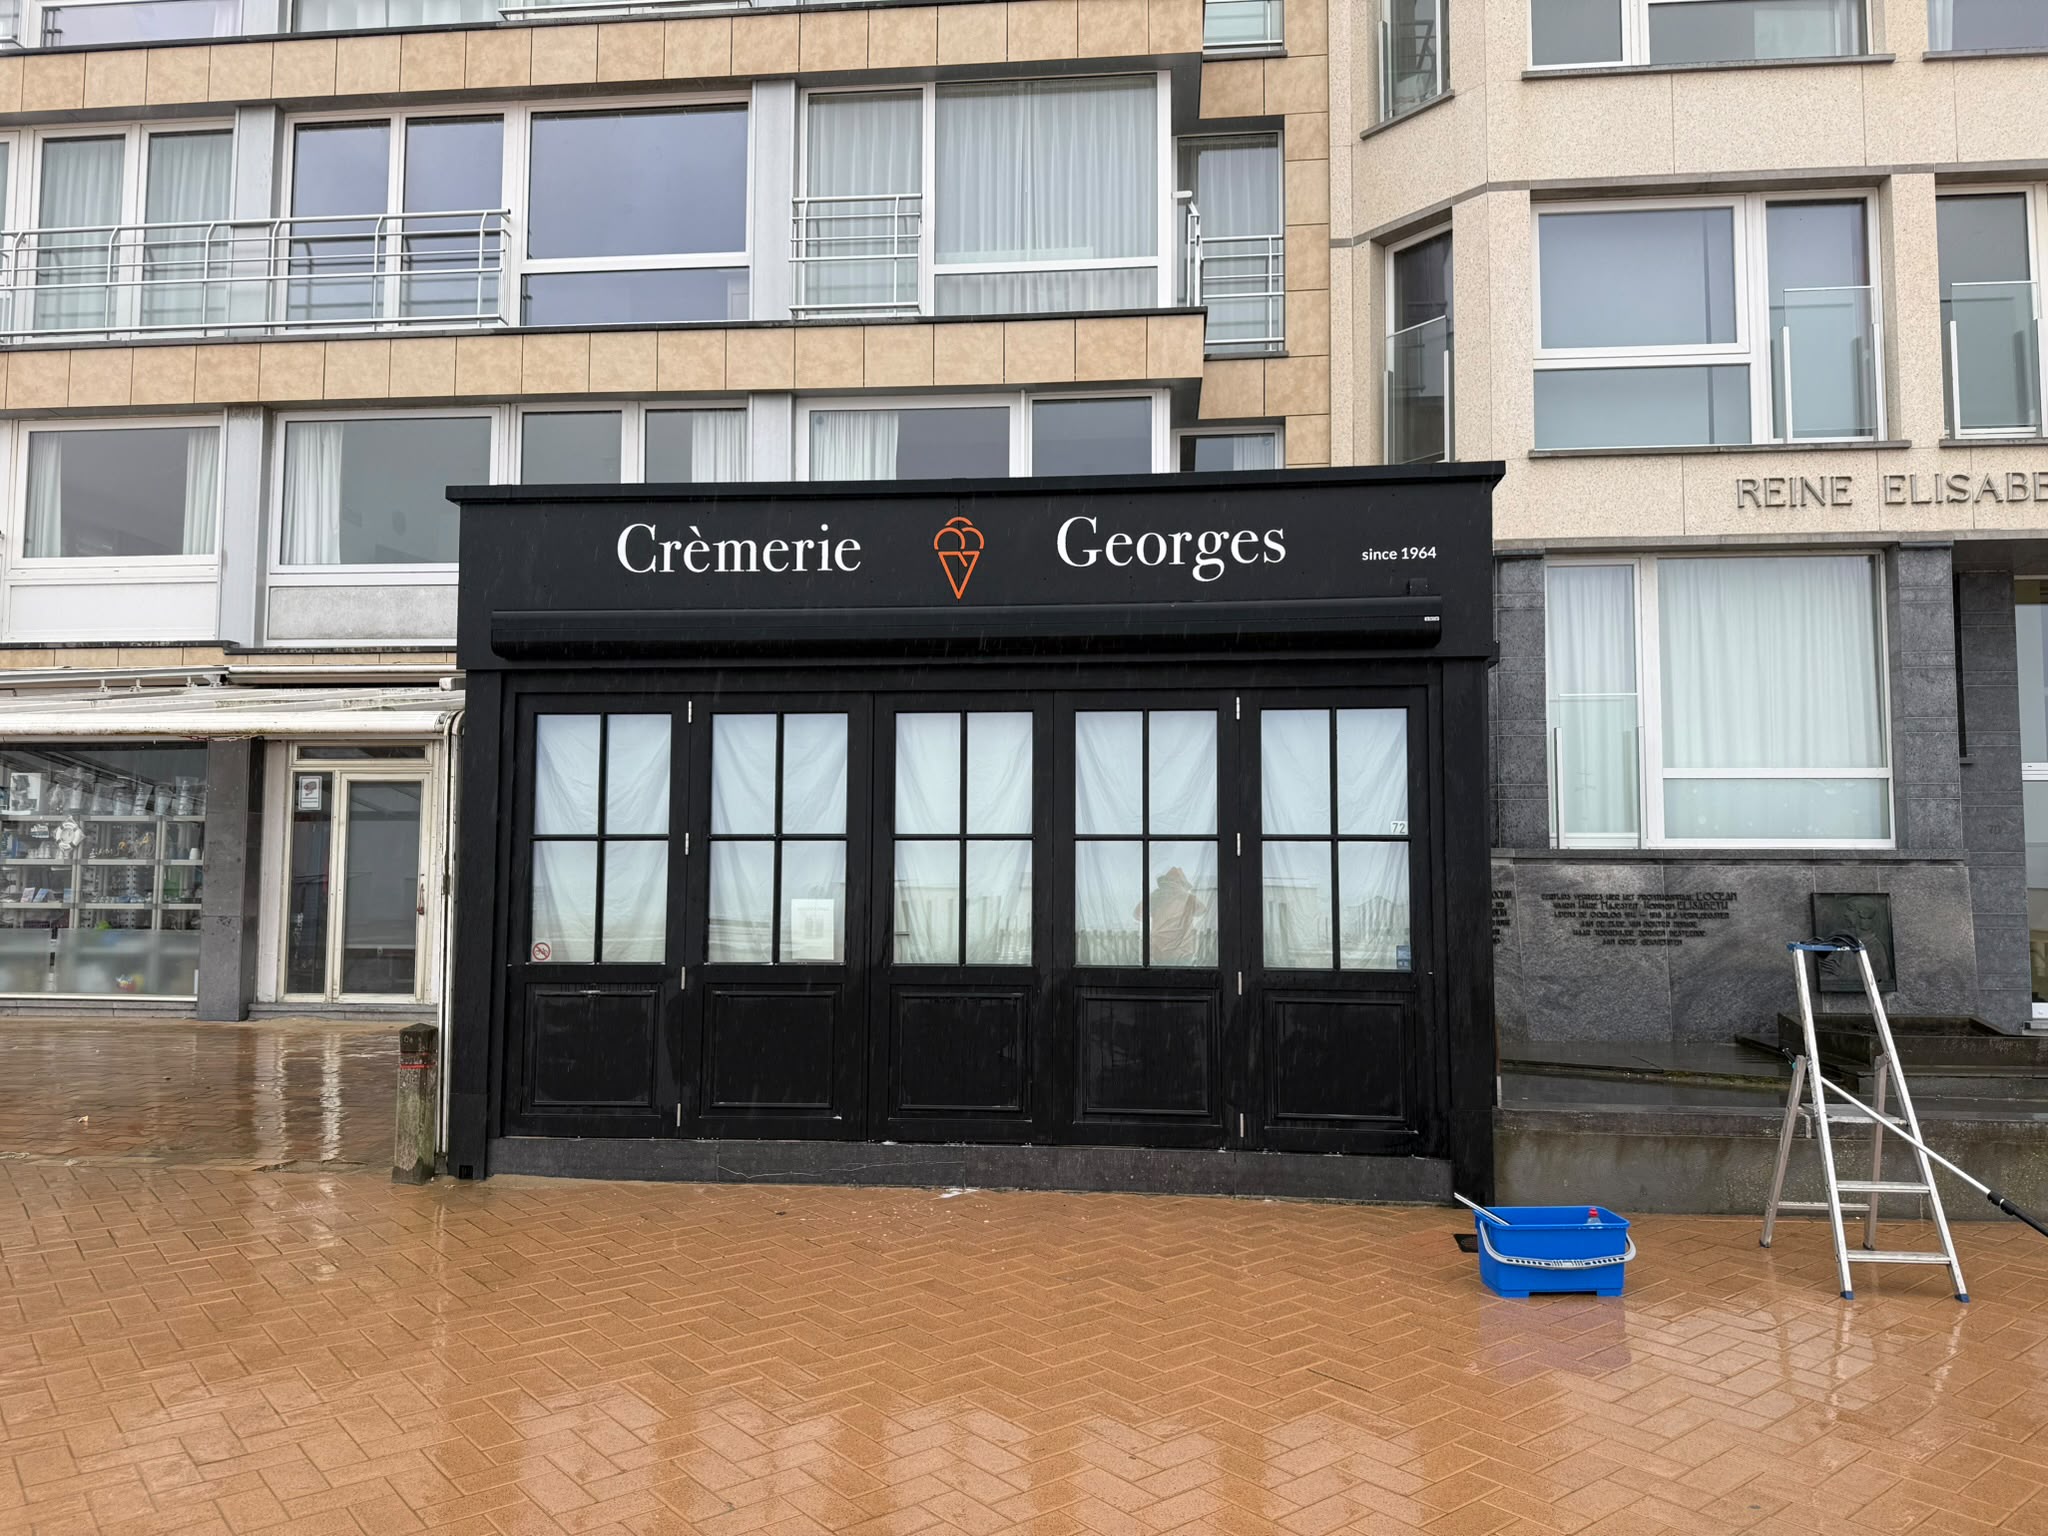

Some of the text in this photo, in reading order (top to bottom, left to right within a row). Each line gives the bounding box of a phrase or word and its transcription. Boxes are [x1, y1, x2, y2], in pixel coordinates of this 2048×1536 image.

[1736, 475, 1853, 509] REINE
[618, 517, 1285, 581] Crèmerie Georges
[1362, 547, 1436, 560] since 1964
[1392, 822, 1406, 834] 72
